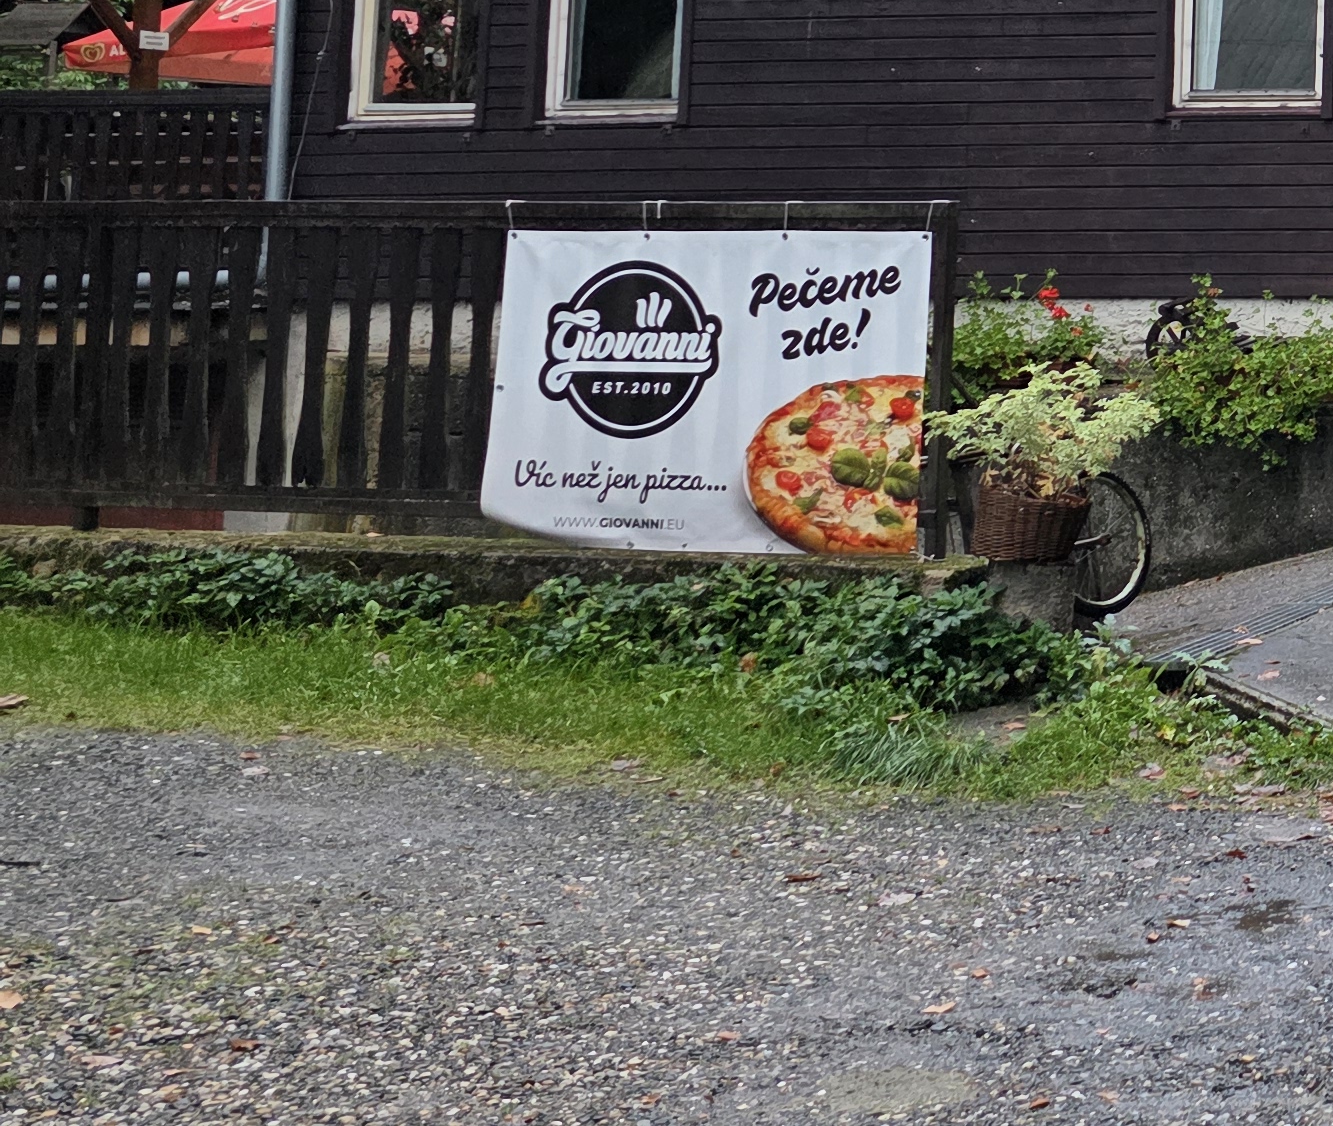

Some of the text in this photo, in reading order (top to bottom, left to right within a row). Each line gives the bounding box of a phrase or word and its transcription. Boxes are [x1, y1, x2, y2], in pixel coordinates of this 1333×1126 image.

[749, 265, 902, 317] Pečeme
[546, 309, 717, 374] Giovanni
[781, 308, 871, 361] zde!
[591, 381, 673, 395] EST.2010
[514, 458, 557, 488] Víc
[561, 460, 602, 490] než
[597, 466, 641, 504] jen
[552, 516, 686, 531] WWW.GIOVANNI.EU
